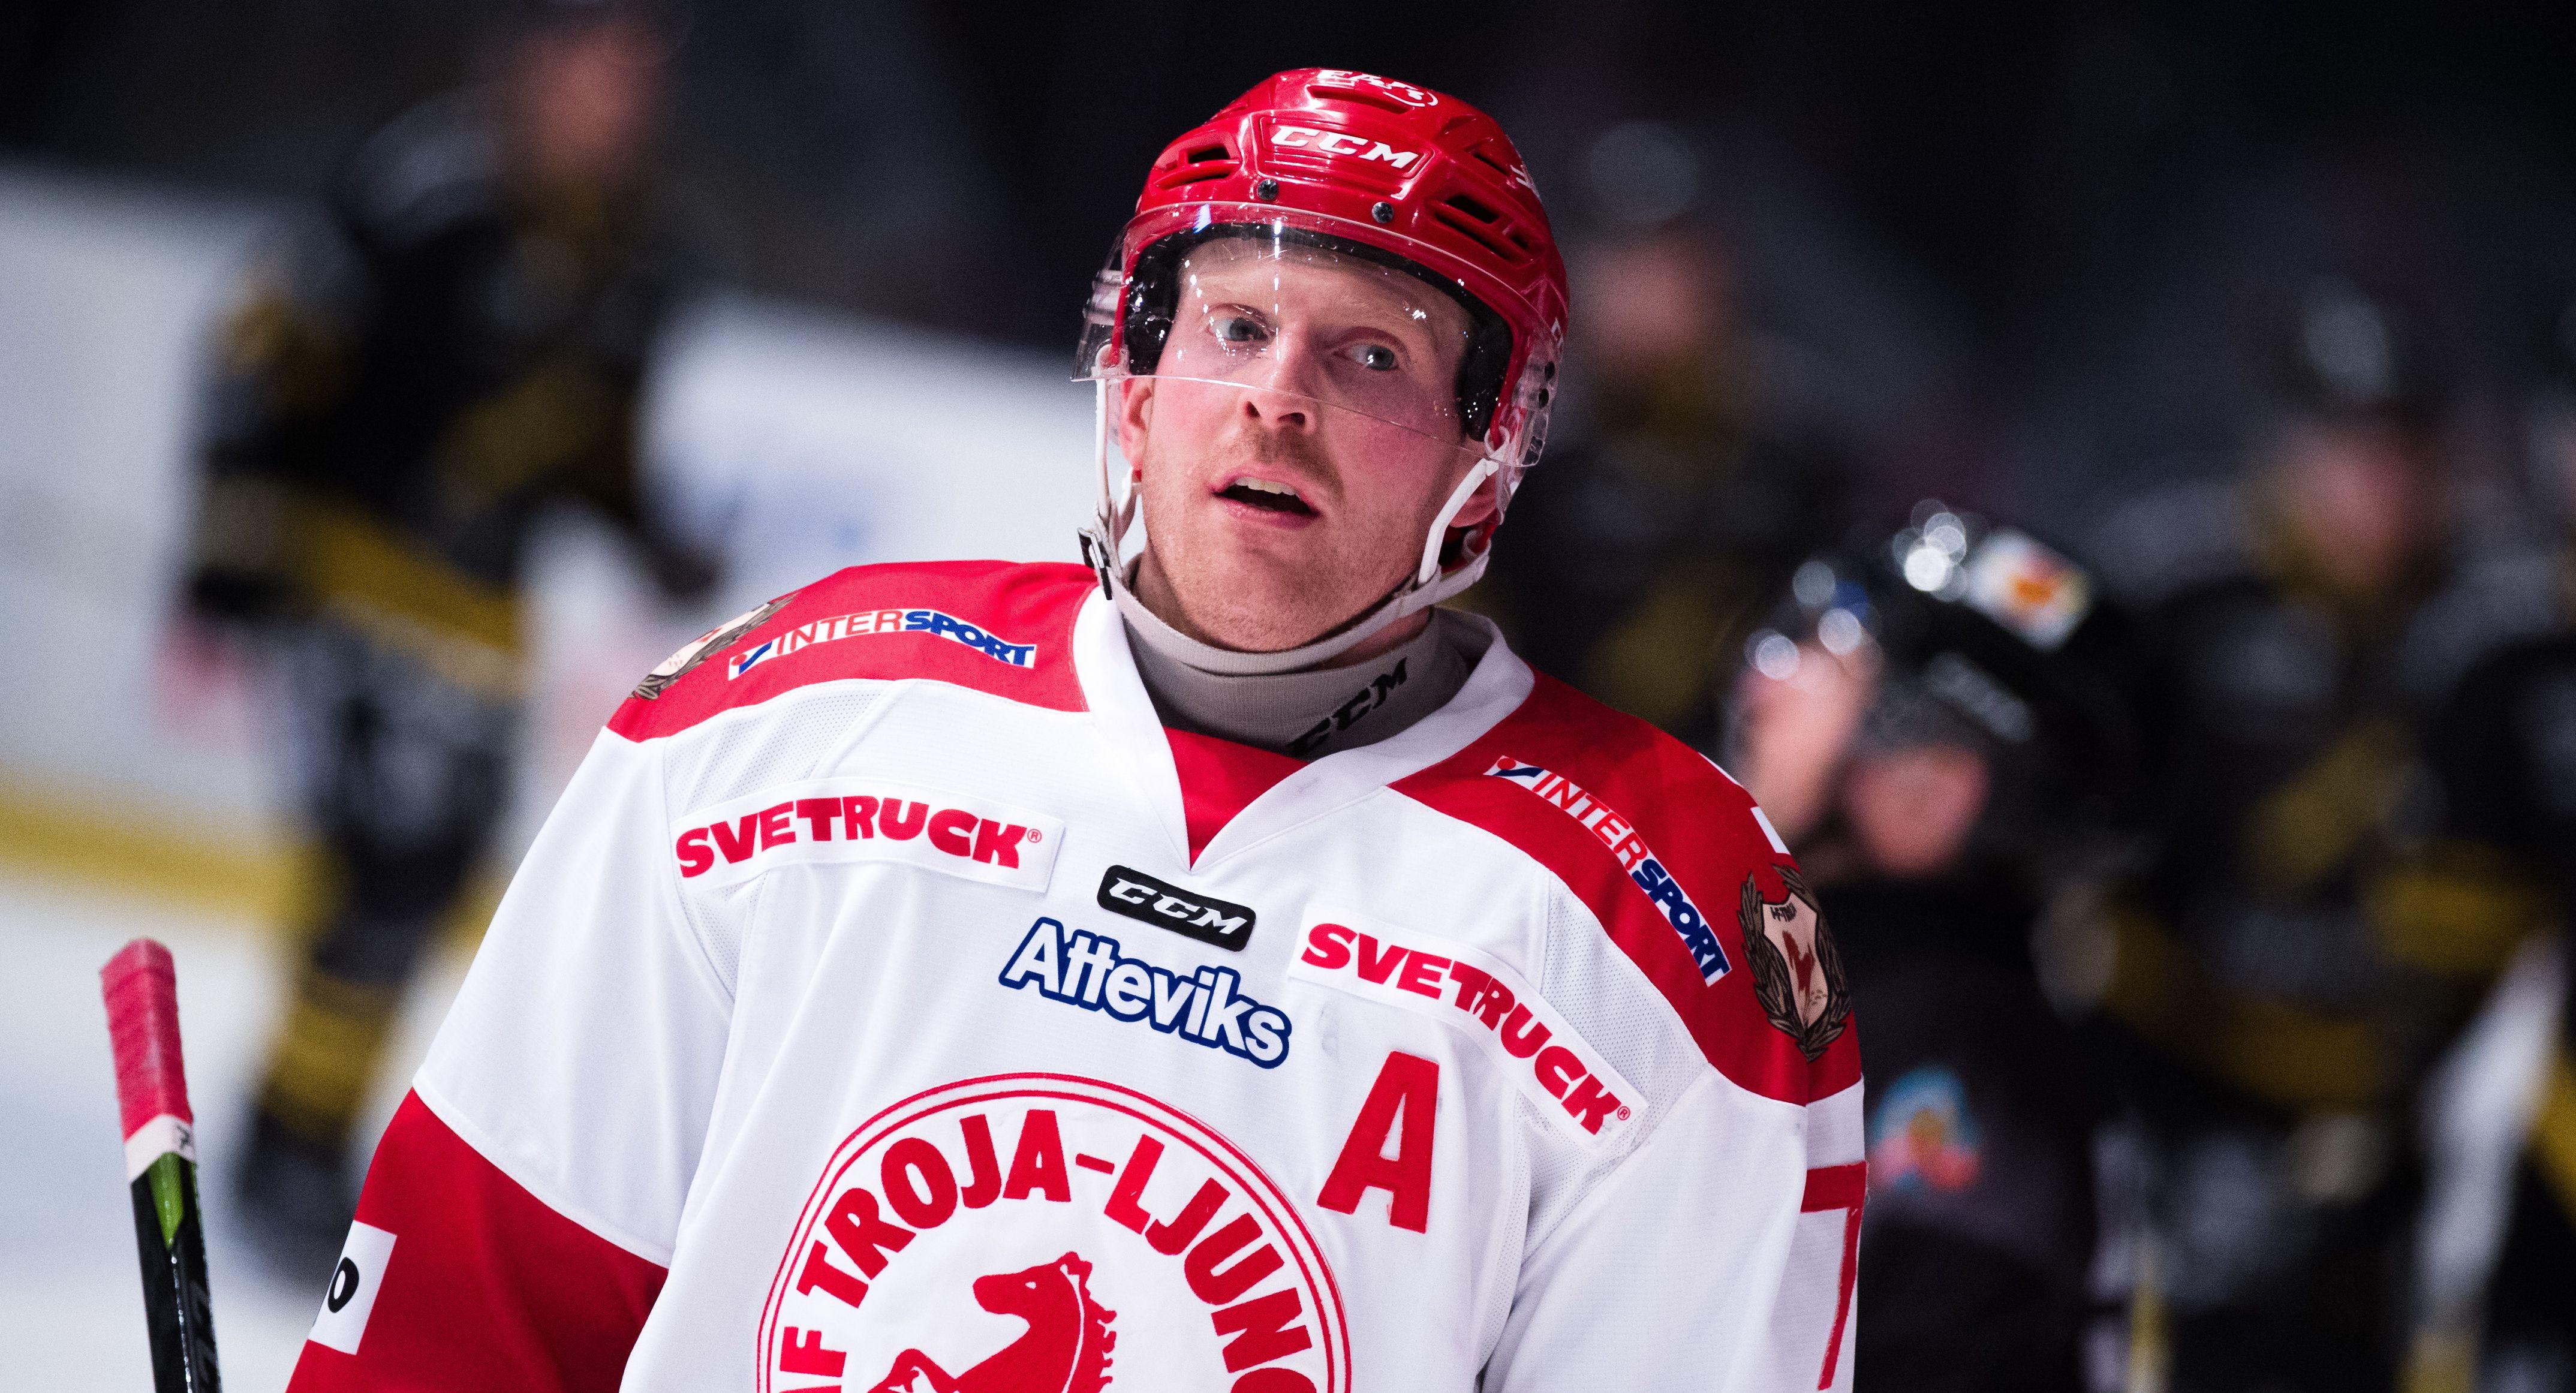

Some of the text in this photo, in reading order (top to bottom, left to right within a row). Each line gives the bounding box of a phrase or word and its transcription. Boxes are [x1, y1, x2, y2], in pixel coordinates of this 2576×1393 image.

[1270, 125, 1419, 171] CCM
[777, 609, 1034, 666] INTERSPORT
[1287, 656, 1408, 755] CCM
[1109, 877, 1247, 934] CCM
[1532, 773, 1729, 978] INTERSPORT
[999, 916, 1292, 1069] Atteviks
[1317, 1051, 1440, 1234] A
[780, 1326, 847, 1393] F
